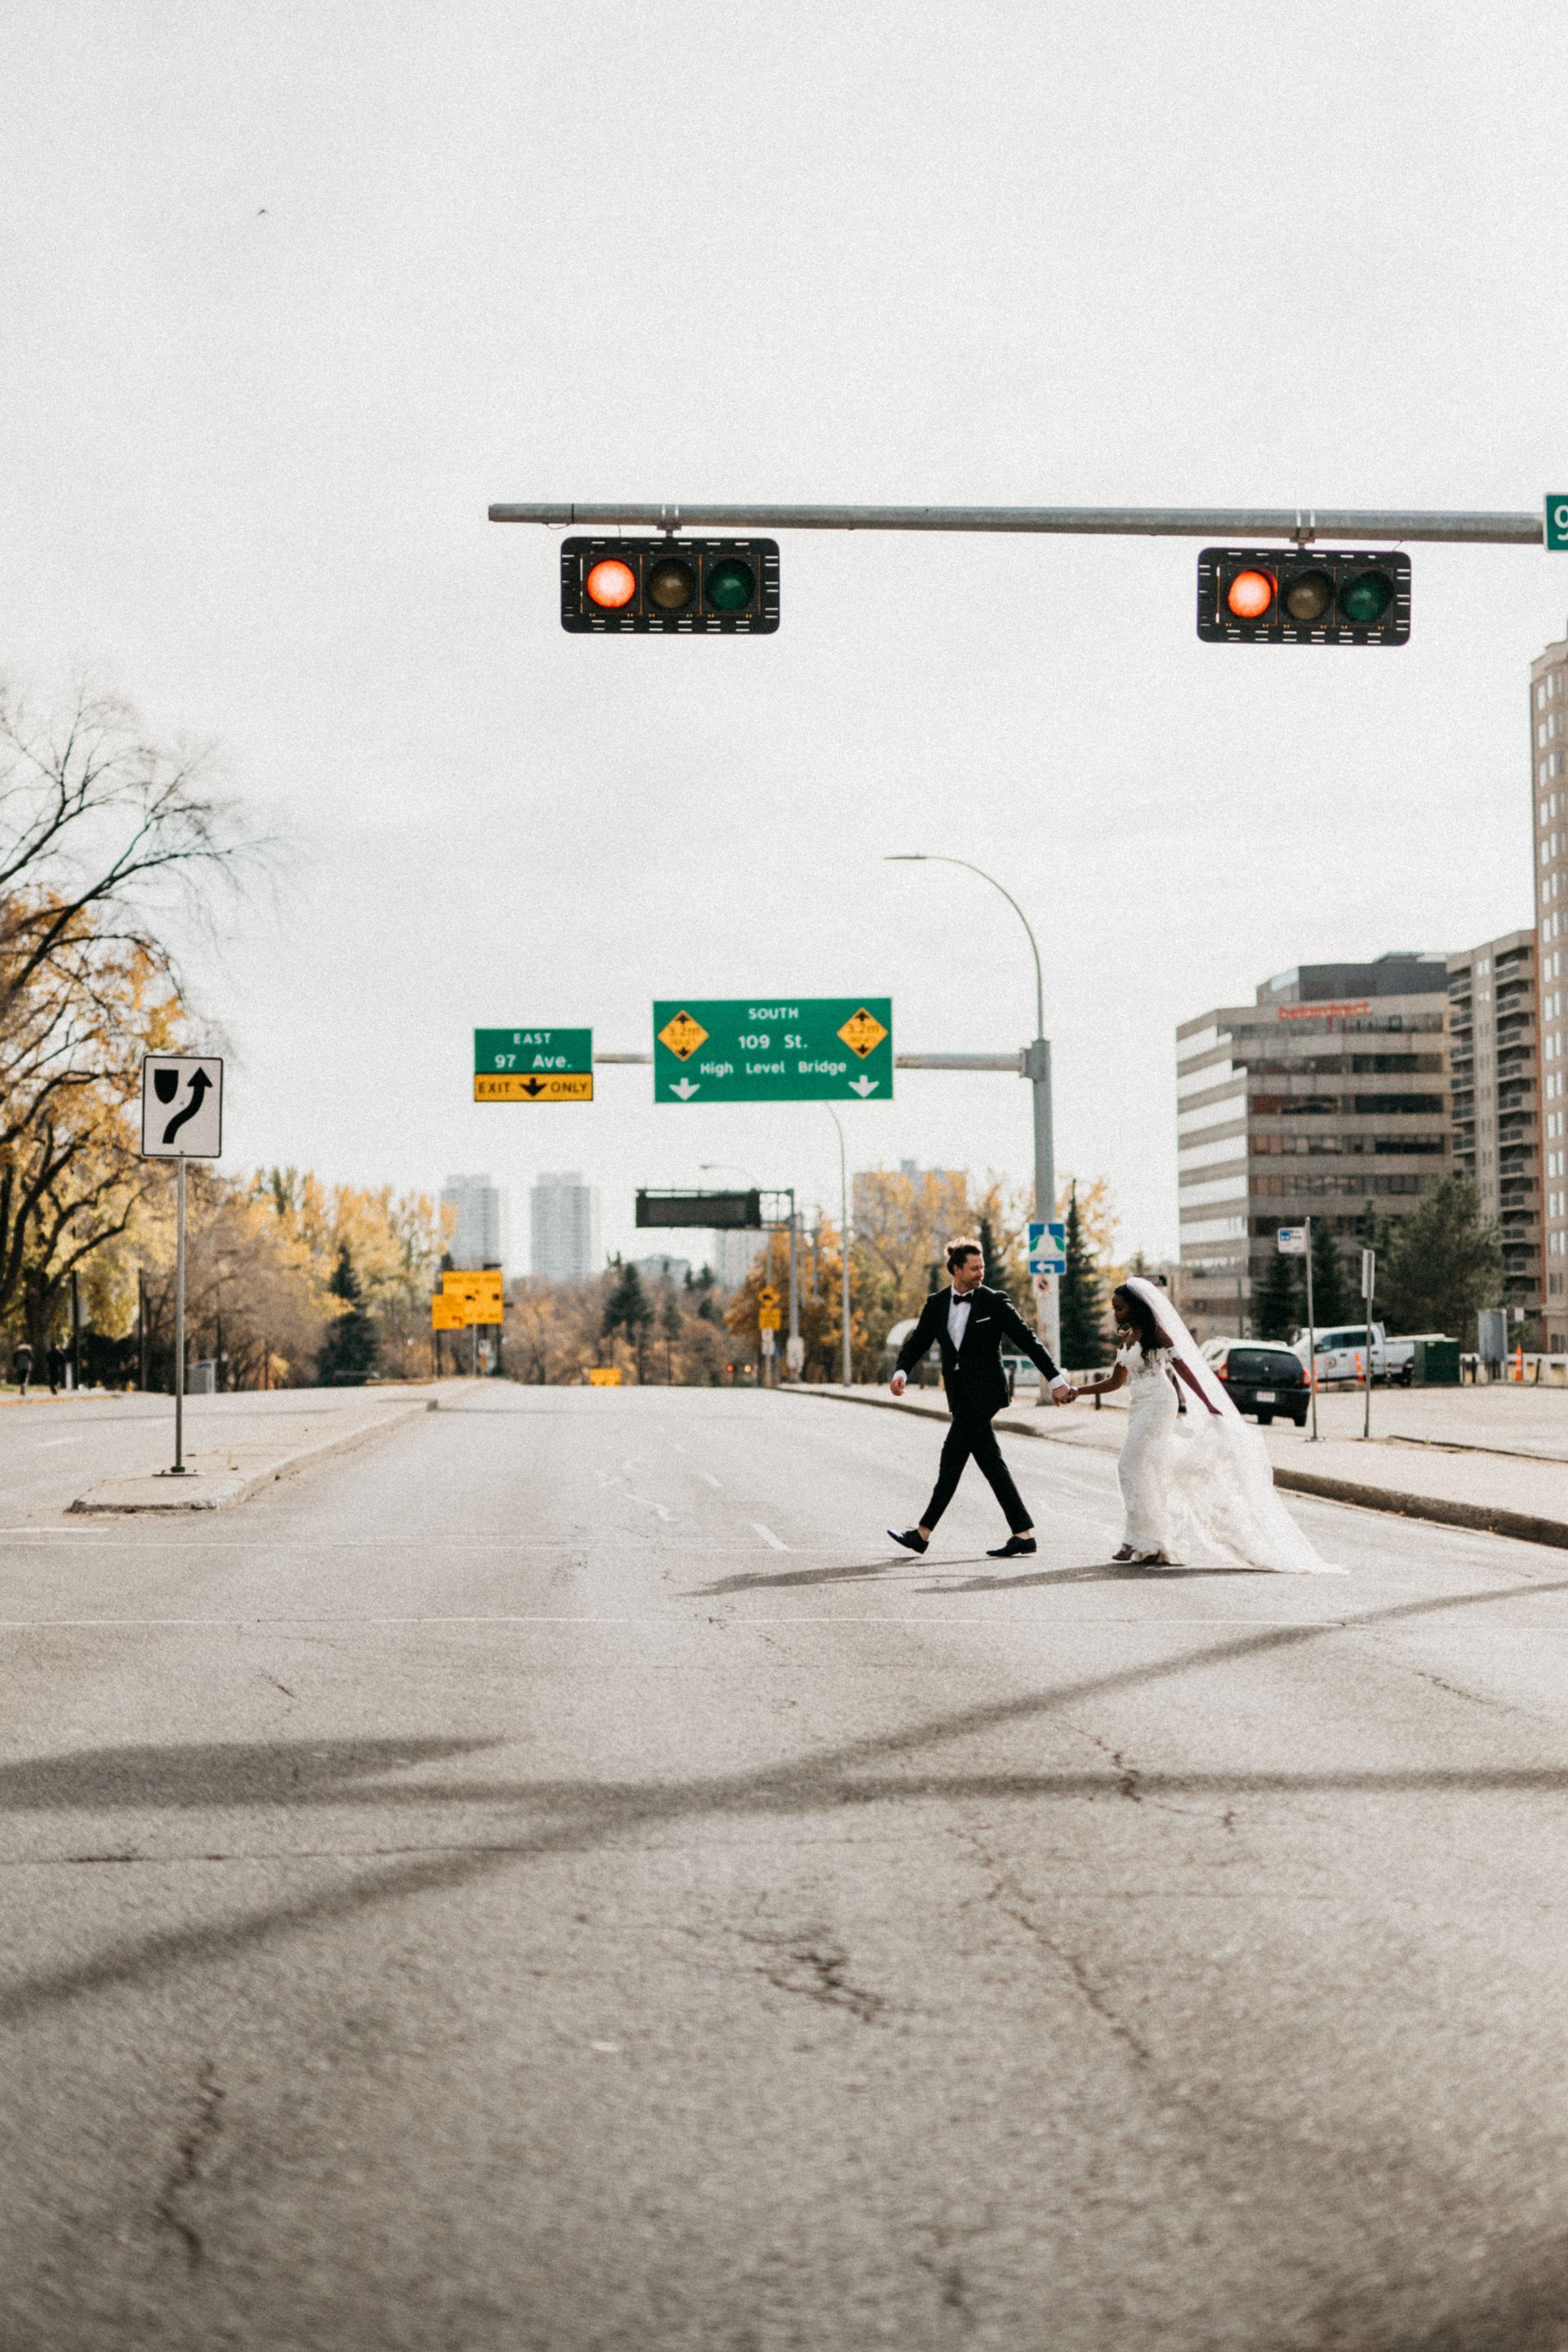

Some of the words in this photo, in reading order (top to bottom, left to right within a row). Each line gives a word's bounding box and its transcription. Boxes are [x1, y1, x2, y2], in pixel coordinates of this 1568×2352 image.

[748, 1007, 799, 1020] SOUTH
[513, 1032, 551, 1045] EAST
[738, 1034, 770, 1049] 109
[784, 1034, 808, 1049] St.
[495, 1054, 516, 1068] 97
[532, 1054, 572, 1068] Ave.
[700, 1061, 733, 1077] High
[746, 1060, 786, 1074] Level
[798, 1059, 847, 1076] Bridge
[478, 1081, 510, 1093] EXIT
[550, 1080, 587, 1093] ONLY
